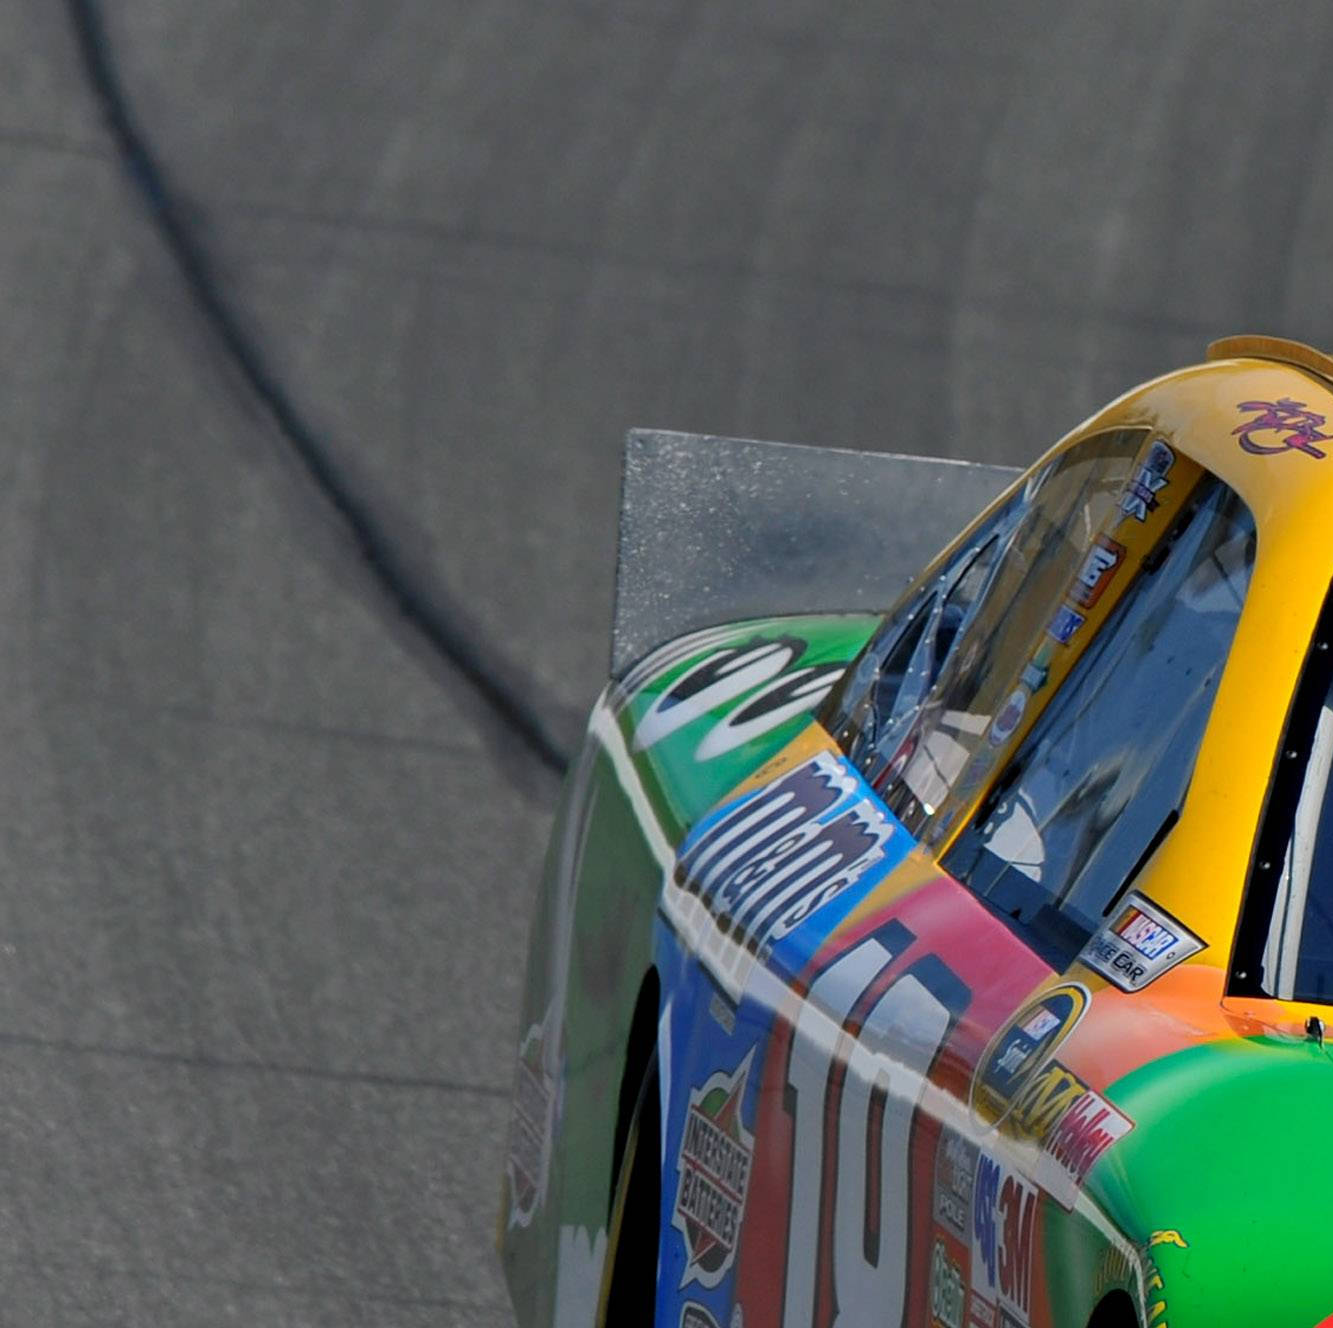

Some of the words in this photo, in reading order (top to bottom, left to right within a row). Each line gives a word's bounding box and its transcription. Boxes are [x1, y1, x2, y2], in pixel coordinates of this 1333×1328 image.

[1113, 948, 1147, 983] CAR
[684, 1110, 748, 1195] INTERSTATE
[681, 1168, 738, 1247] BATTERIES
[999, 1174, 1036, 1315] 3M
